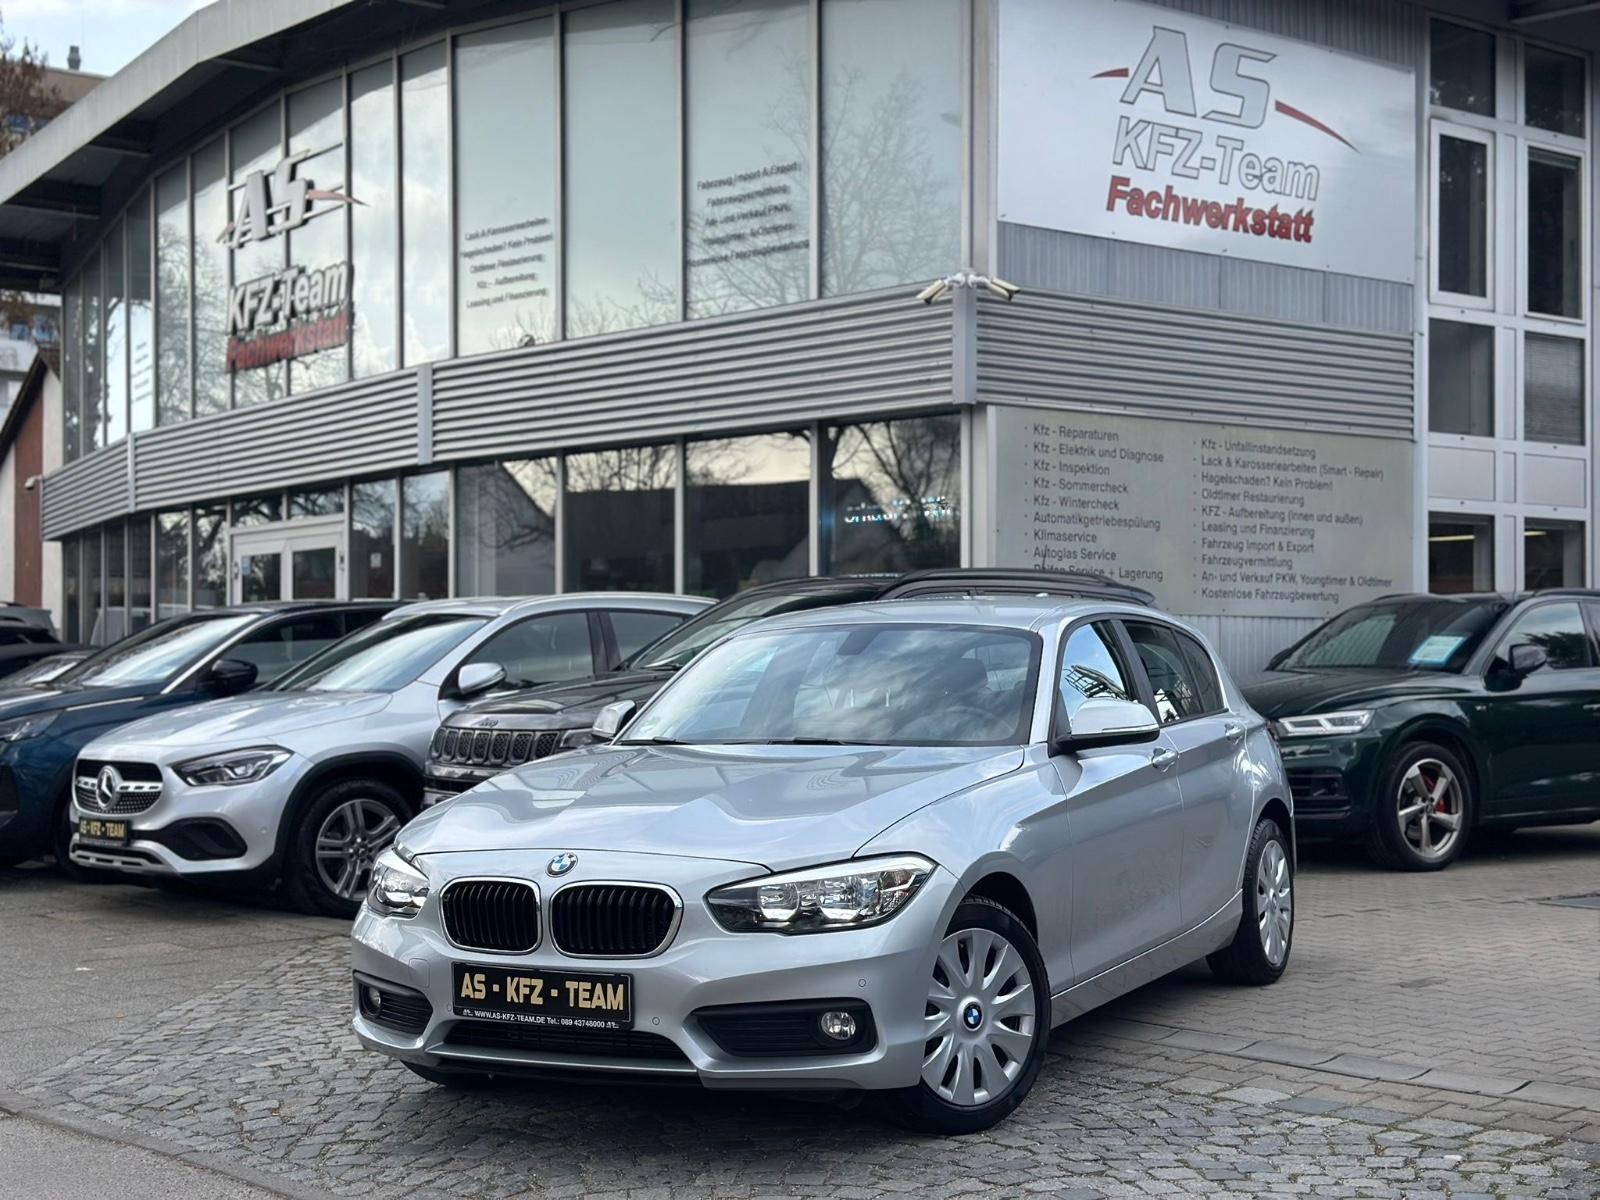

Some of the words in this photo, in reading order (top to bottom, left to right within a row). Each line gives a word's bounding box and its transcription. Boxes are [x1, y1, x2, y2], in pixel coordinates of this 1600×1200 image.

[1119, 25, 1278, 129] AS
[1112, 115, 1321, 201] KFZ-Team
[223, 149, 314, 249] AS
[1105, 174, 1315, 243] Fachwerkstatt
[225, 261, 354, 335] KFZ-Team
[1033, 424, 1050, 434] Kfz
[1059, 426, 1119, 441] Reparaturen
[1033, 442, 1050, 452] Kfz
[1059, 443, 1096, 457] Elektrik
[1099, 449, 1117, 458] und
[1120, 448, 1164, 463] Diagnose
[1201, 439, 1216, 449] Kfz
[1225, 440, 1316, 460] Unfallinstandsetzung
[1033, 460, 1050, 470] Kfz
[1059, 462, 1110, 476] Inspektion
[1201, 456, 1222, 467] Lack
[1235, 458, 1317, 474] Karosseriearbeiten
[1033, 477, 1050, 488] Kfz
[1059, 478, 1128, 493] Sommercheck
[1201, 472, 1270, 487] Hagelschaden?
[1273, 477, 1293, 488] Kein
[1033, 495, 1050, 506] Kfz
[1059, 496, 1120, 510] Wintercheck
[1201, 488, 1240, 501] Oldtimer
[1243, 490, 1304, 507] Restaurierung
[1033, 512, 1161, 531] Automatikgetriebespülung
[1201, 506, 1220, 516] KFZ
[1229, 507, 1285, 522] Aufbereitung
[1317, 512, 1332, 522] und
[1033, 529, 1097, 543] Klimaservice
[1201, 522, 1237, 535] Leasing
[1240, 524, 1257, 534] und
[1260, 524, 1315, 539] Finanzierung
[1033, 547, 1078, 561] Autoglas
[1080, 549, 1116, 561] Service
[1201, 538, 1244, 552] Fahrzeug
[1246, 540, 1275, 552] Import
[1286, 542, 1314, 553] Export
[1201, 554, 1293, 570] Fahrzeugvermittlung
[1119, 568, 1164, 583] Lagerung
[1201, 571, 1218, 581] An-
[1220, 572, 1237, 582] und
[1239, 572, 1273, 583] Verkauf
[1201, 587, 1251, 600] Kostenlose
[1255, 588, 1339, 604] Fahrzeugbewertung
[461, 972, 486, 999] AS
[507, 976, 543, 1005] KFZ
[565, 981, 624, 1010] TEAM
[474, 1010, 546, 1024] WWW.AS-KFZ-TEAM.DE
